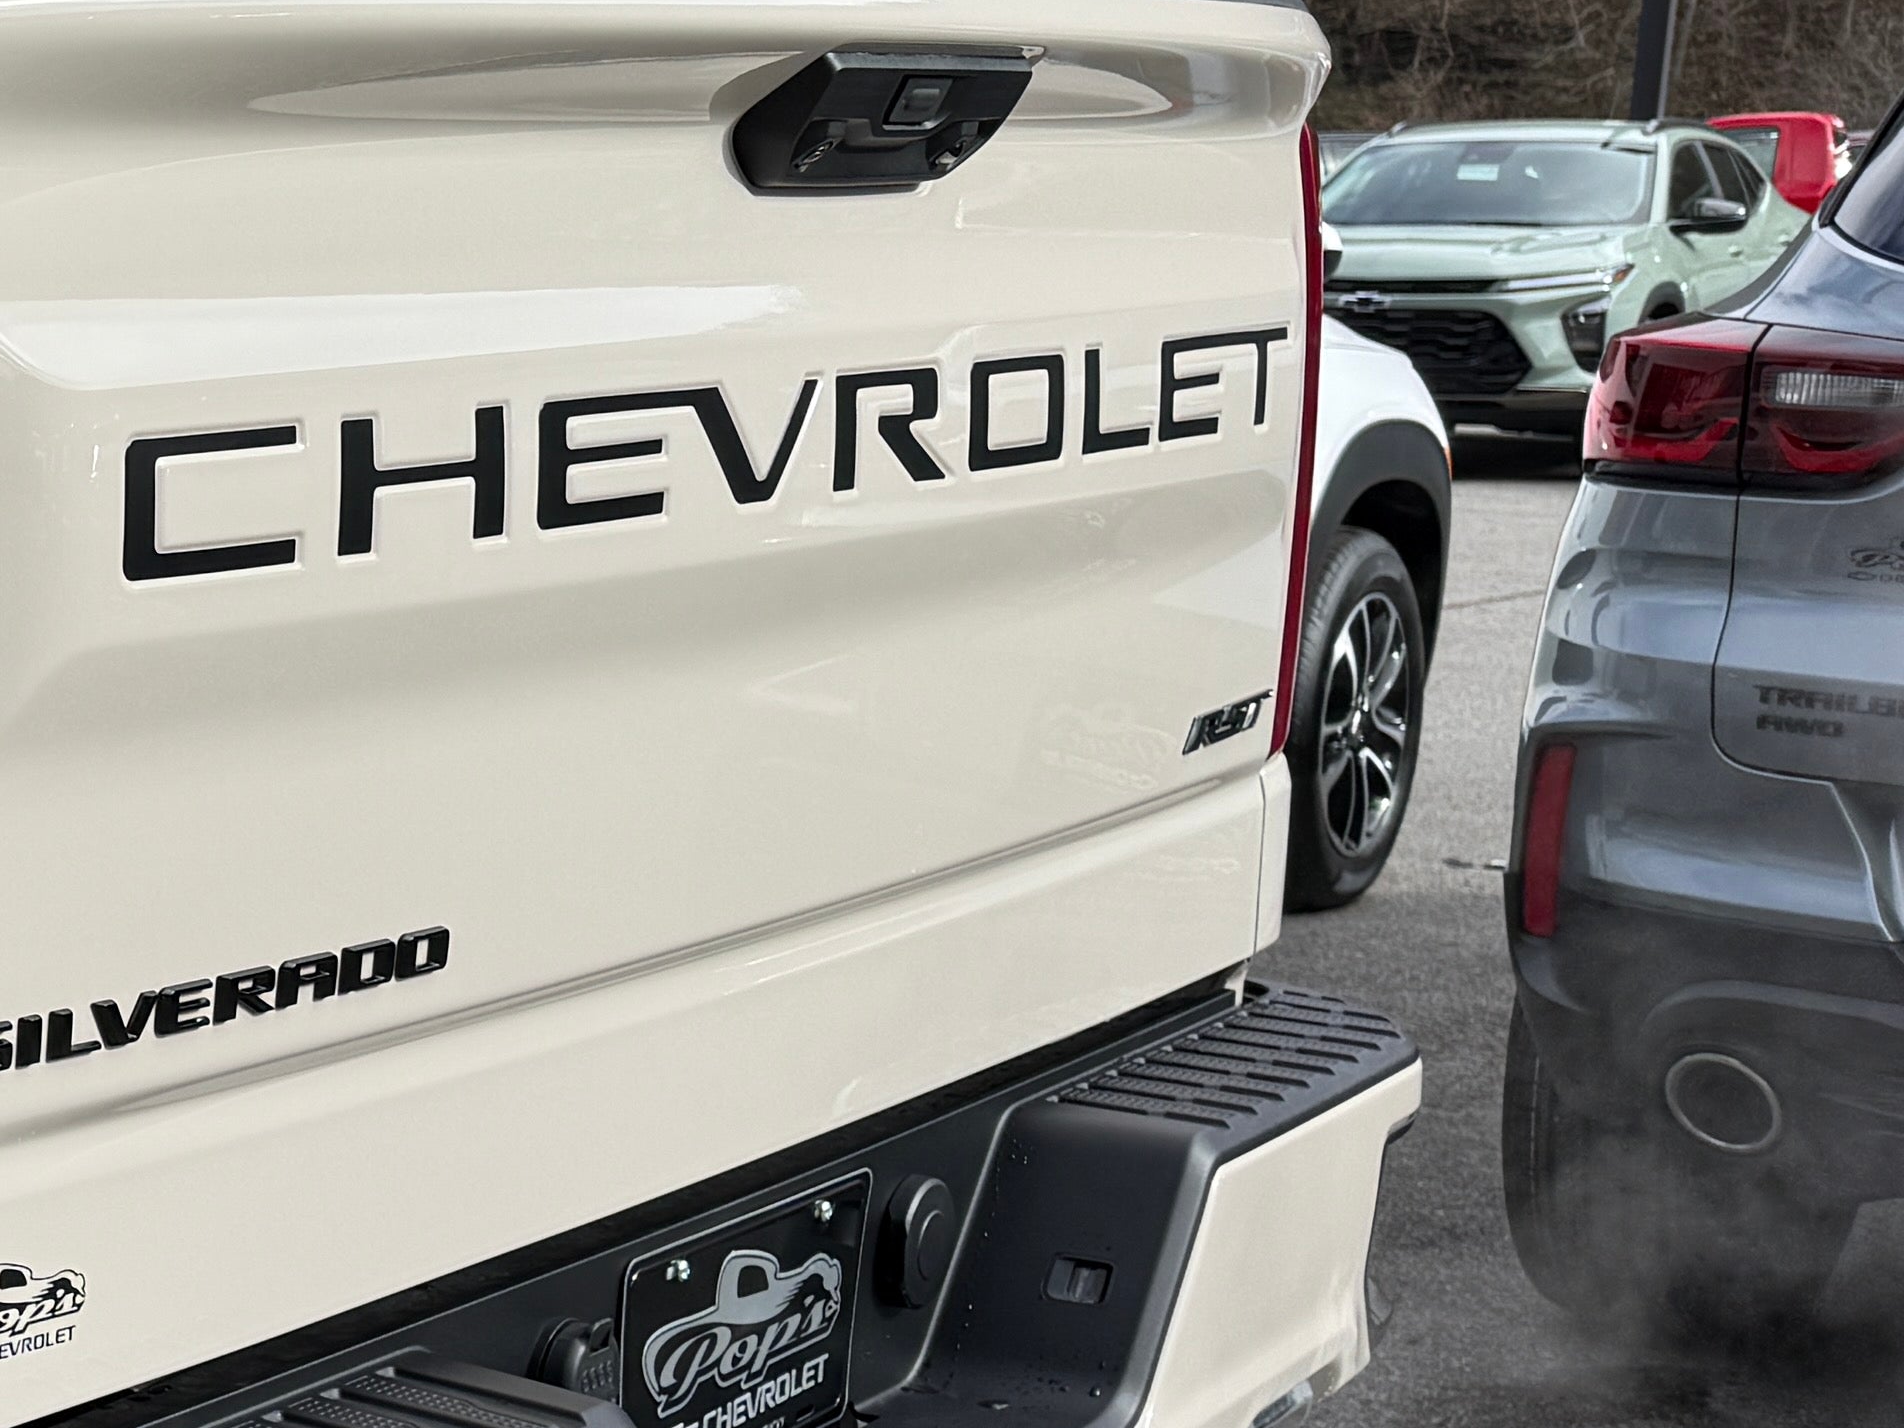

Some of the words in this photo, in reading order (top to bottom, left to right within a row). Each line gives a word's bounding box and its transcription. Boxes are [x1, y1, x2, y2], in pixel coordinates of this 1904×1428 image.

[122, 324, 1290, 583] CHEVROLET
[1182, 688, 1275, 756] RST
[1753, 683, 1904, 720] TRAILB
[1755, 714, 1845, 738] AWD
[659, 1296, 833, 1404] Pop's
